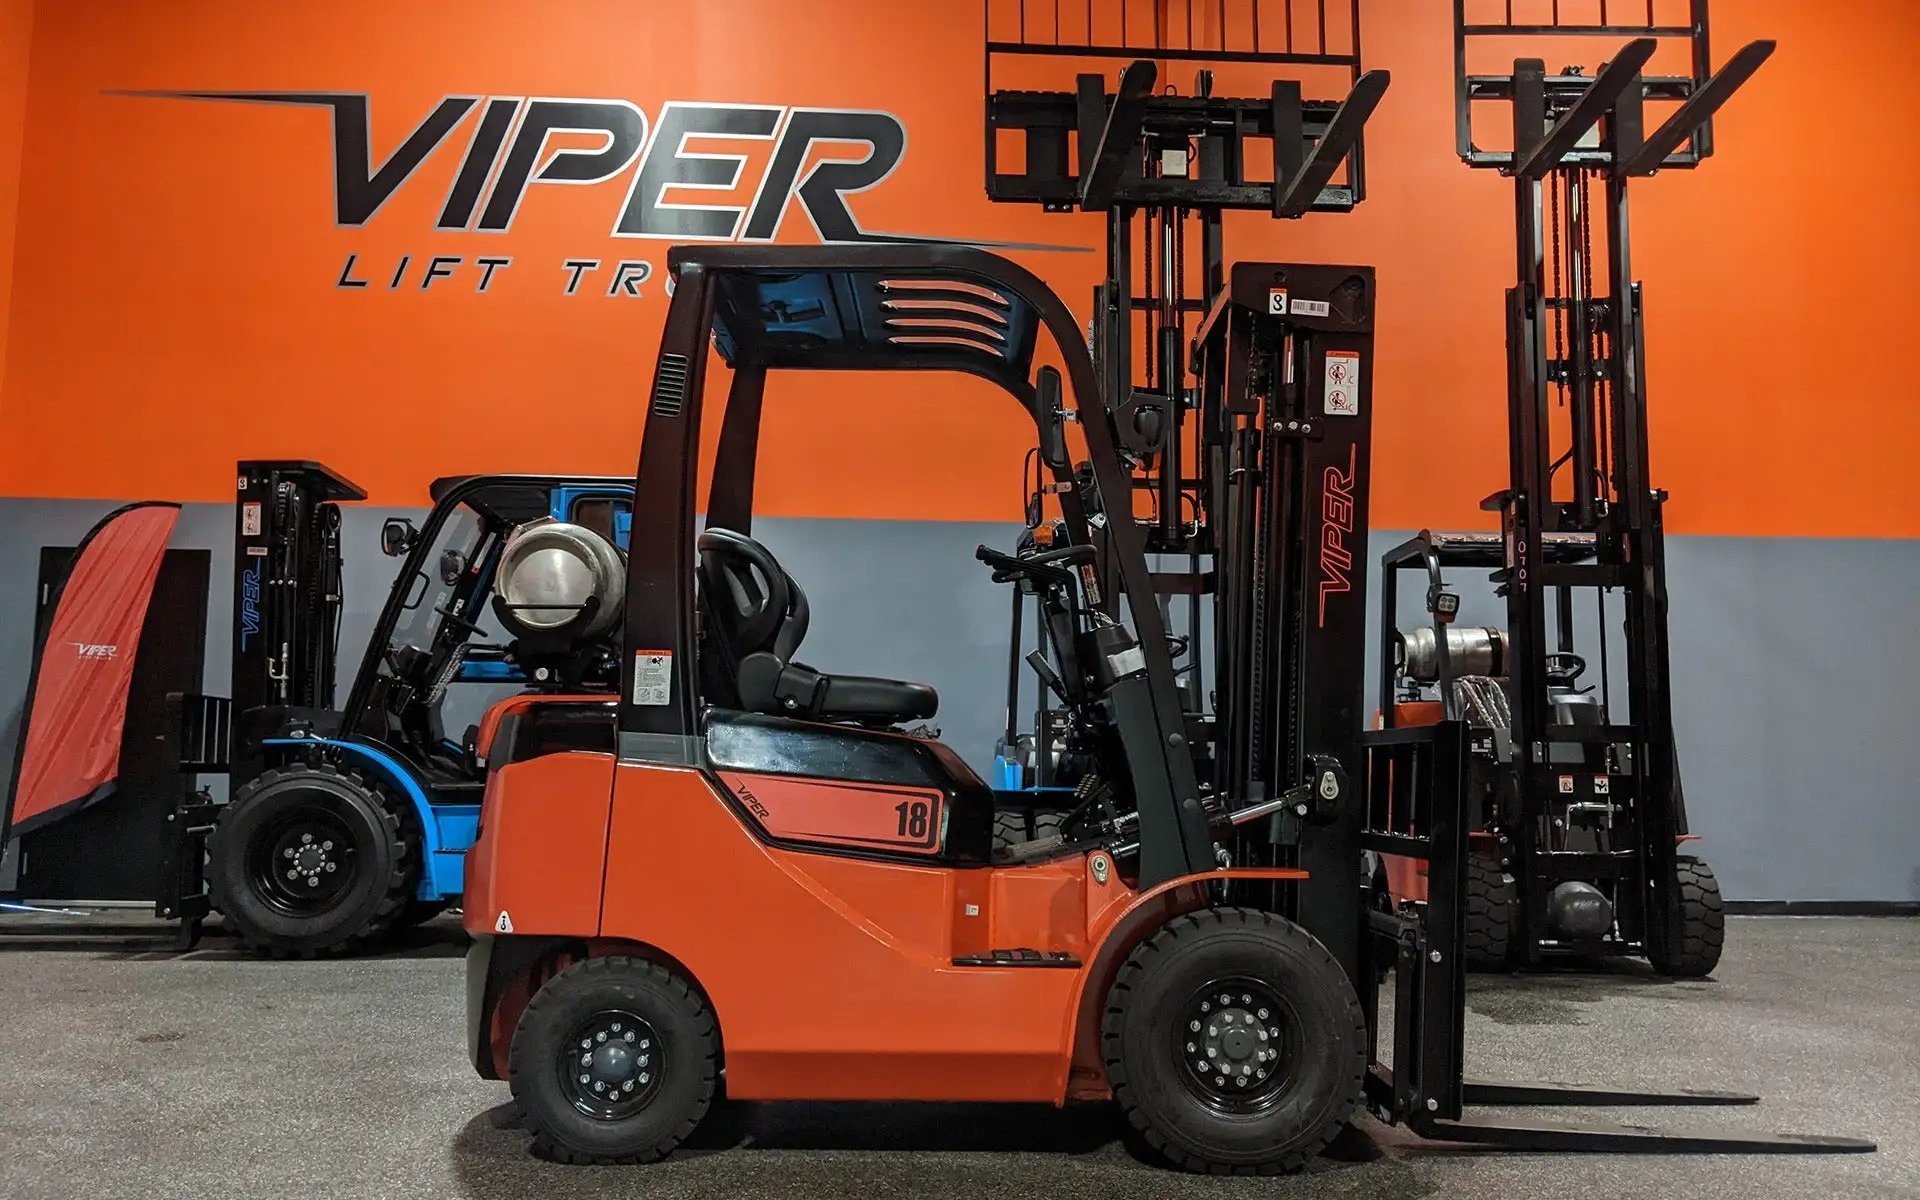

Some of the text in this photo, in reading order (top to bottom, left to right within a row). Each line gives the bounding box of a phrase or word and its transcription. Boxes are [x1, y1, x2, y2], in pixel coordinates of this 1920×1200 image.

[98, 90, 1096, 251] VIPER
[336, 253, 676, 298] LIFT TR
[1317, 443, 1357, 628] VIPER
[242, 557, 262, 653] VIPER
[66, 642, 118, 657] VIPER
[736, 776, 770, 821] VIPER
[894, 801, 928, 839] 18
